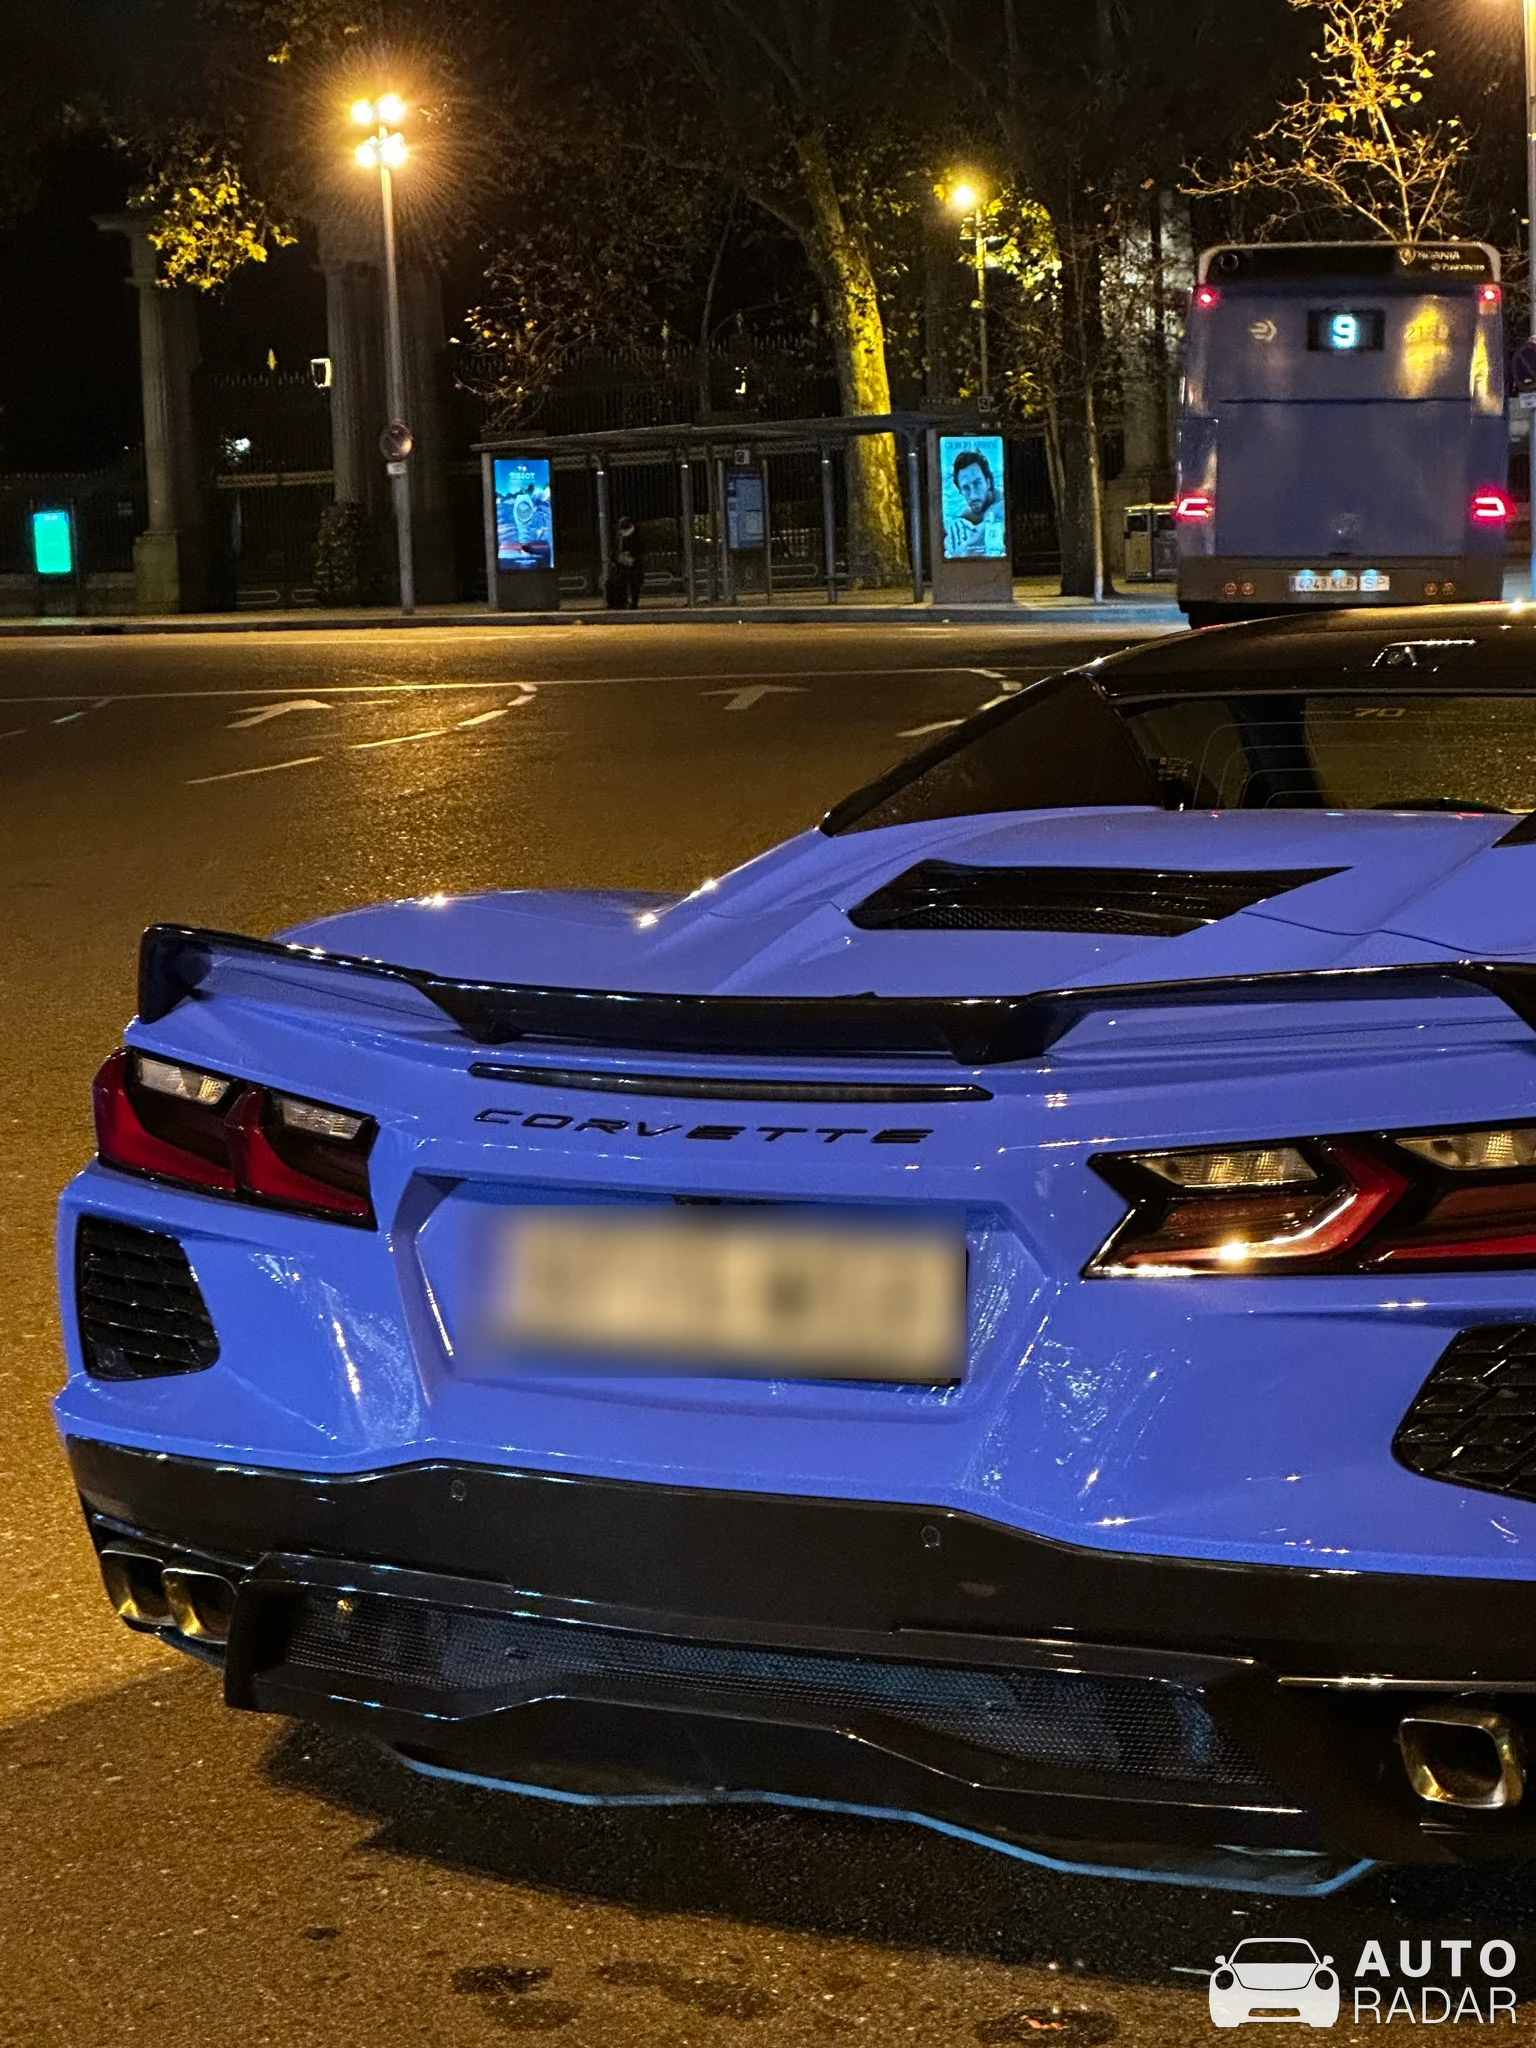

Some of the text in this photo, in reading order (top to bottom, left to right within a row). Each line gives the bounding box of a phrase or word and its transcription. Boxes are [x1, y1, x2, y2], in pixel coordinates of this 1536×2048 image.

[1331, 313, 1359, 349] 9
[1364, 577, 1386, 589] SP
[473, 1107, 935, 1144] CORVETTE
